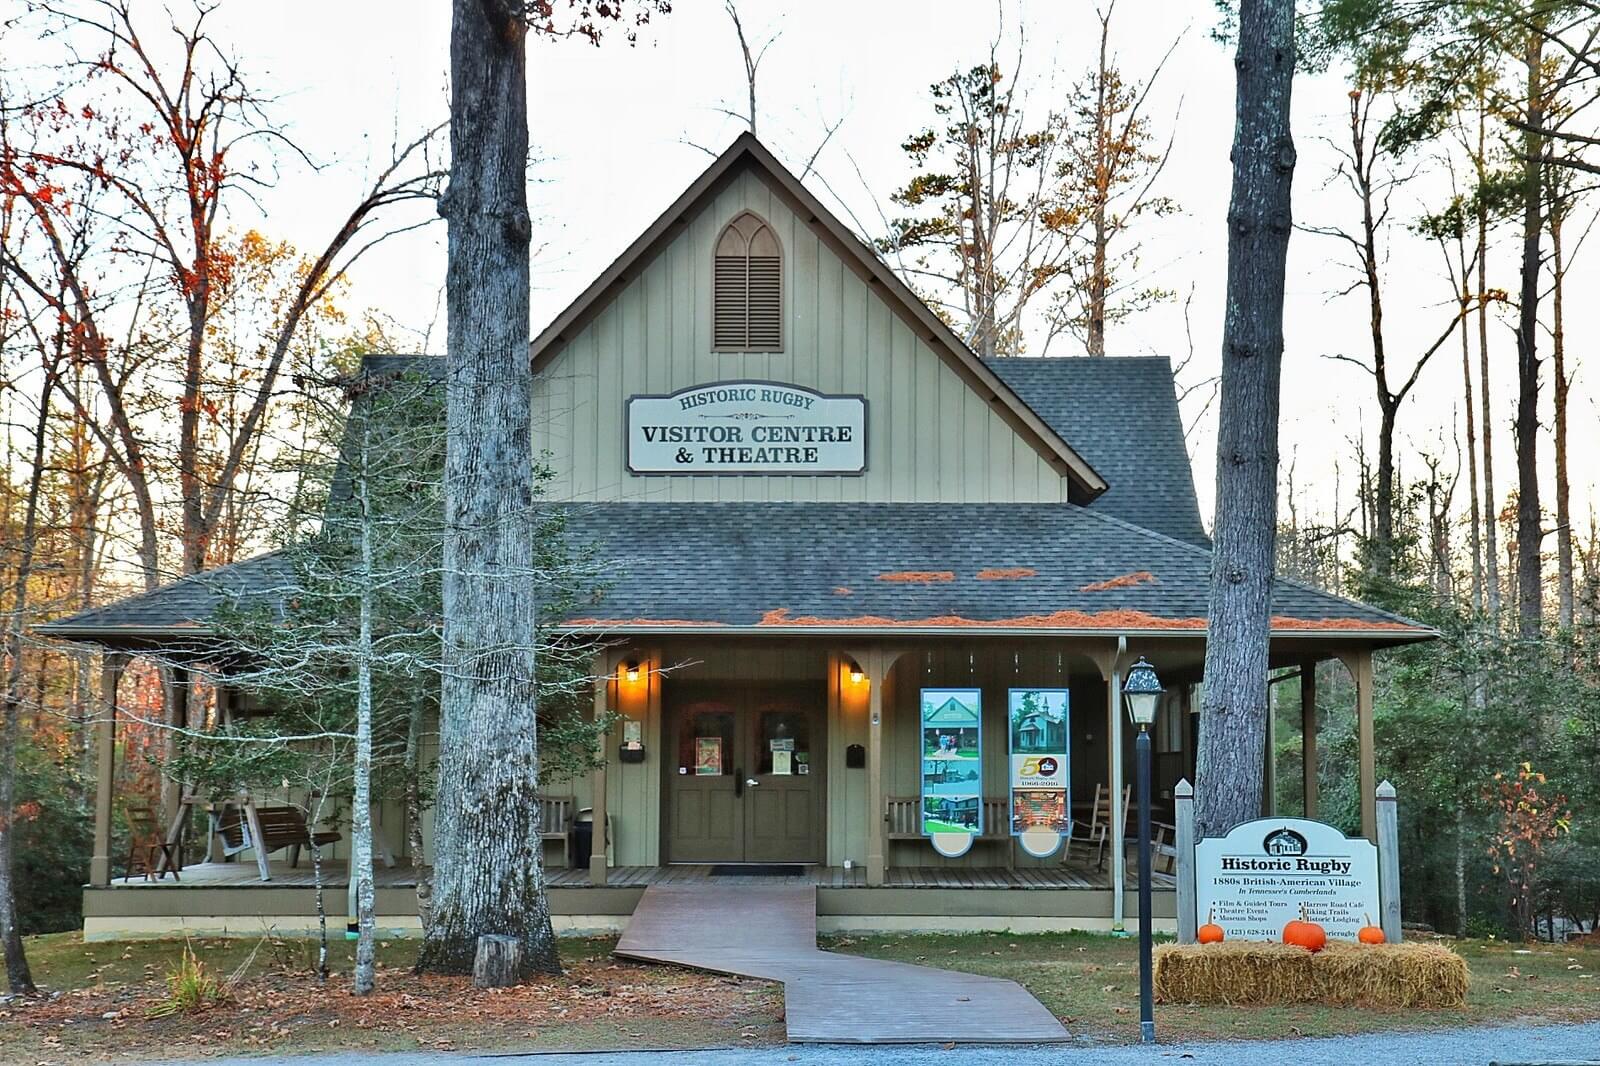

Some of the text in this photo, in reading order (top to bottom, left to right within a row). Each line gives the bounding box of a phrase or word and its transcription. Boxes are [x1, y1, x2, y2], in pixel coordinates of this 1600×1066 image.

[680, 388, 815, 411] HISTORIC RUGBY
[641, 426, 852, 443] VISITOR CENTRE
[675, 446, 818, 464] & THEATRE
[1221, 857, 1351, 875] Historic Rugby
[1213, 877, 1362, 887] 1880s British-American Village
[1238, 887, 1246, 895] In
[1248, 887, 1288, 895] Tennessee's
[1332, 916, 1360, 924] Lodging
